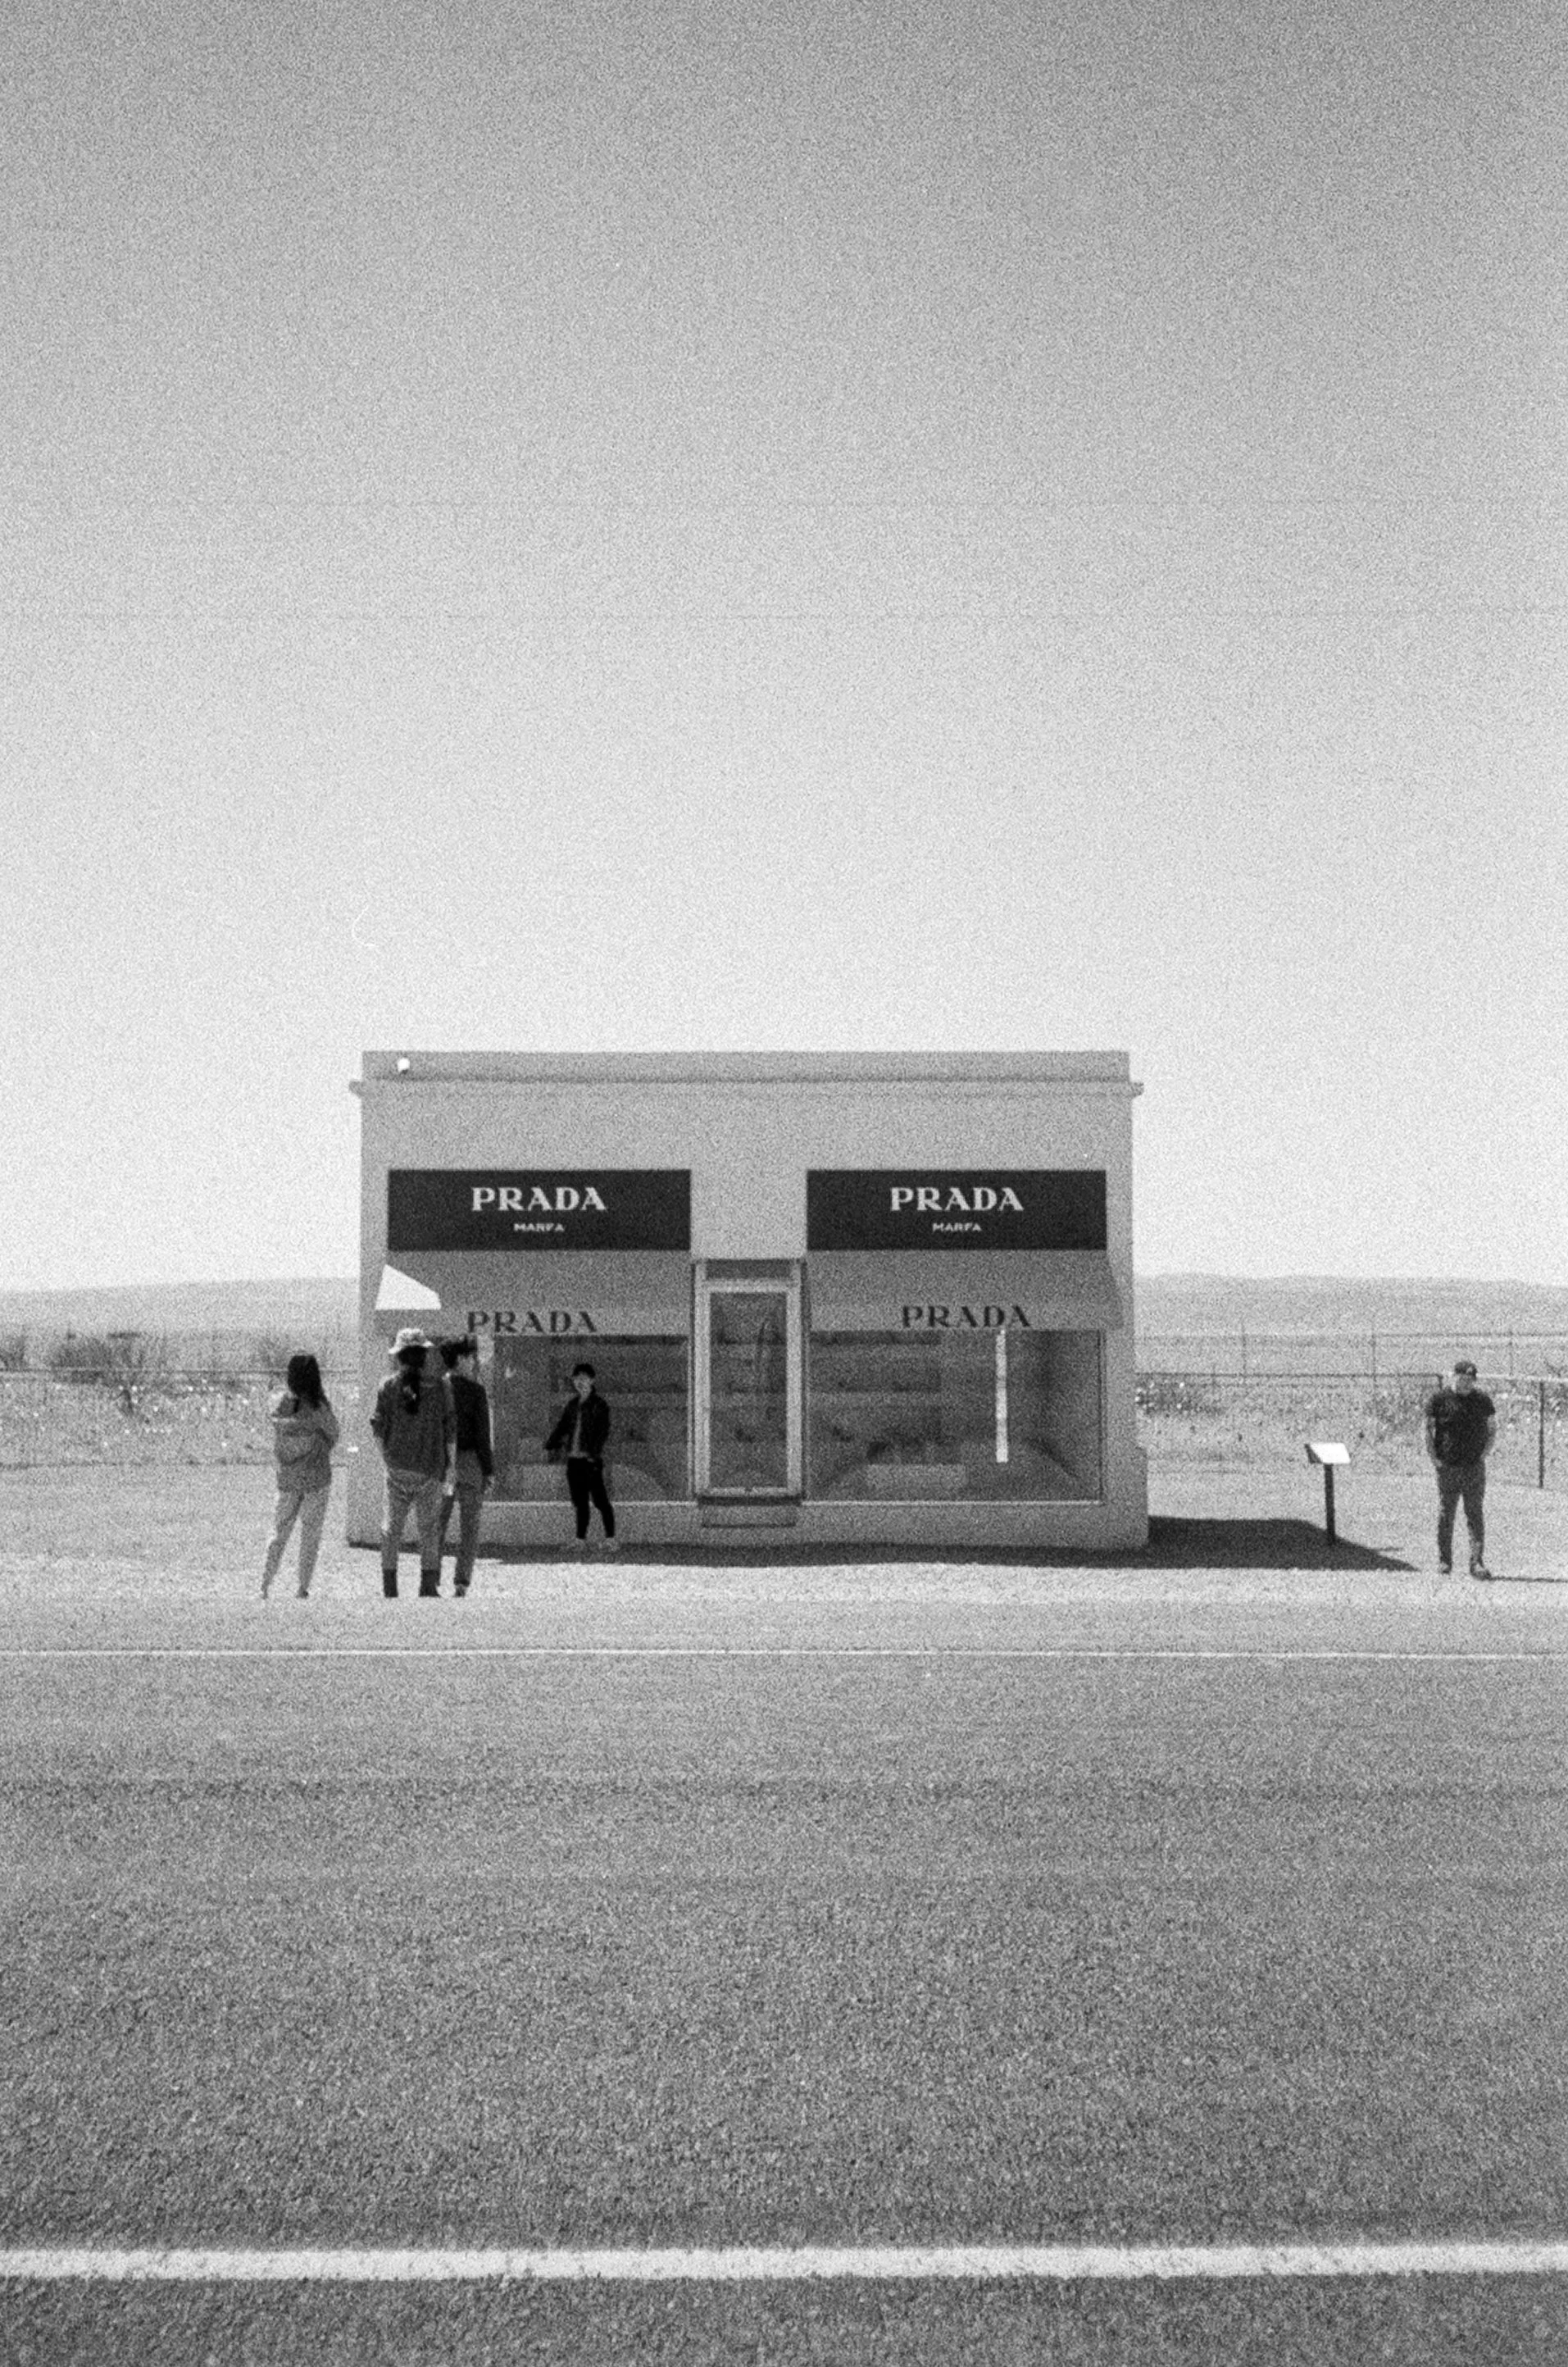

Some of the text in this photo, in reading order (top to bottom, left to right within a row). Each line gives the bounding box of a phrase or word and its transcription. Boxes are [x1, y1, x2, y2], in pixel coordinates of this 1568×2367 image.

[472, 1187, 607, 1211] PRADA
[891, 1187, 1024, 1211] PRADA
[513, 1222, 565, 1232] MARFA
[932, 1222, 982, 1232] MARFA
[467, 1311, 598, 1333] PRADA
[902, 1305, 1030, 1328] PRADA
